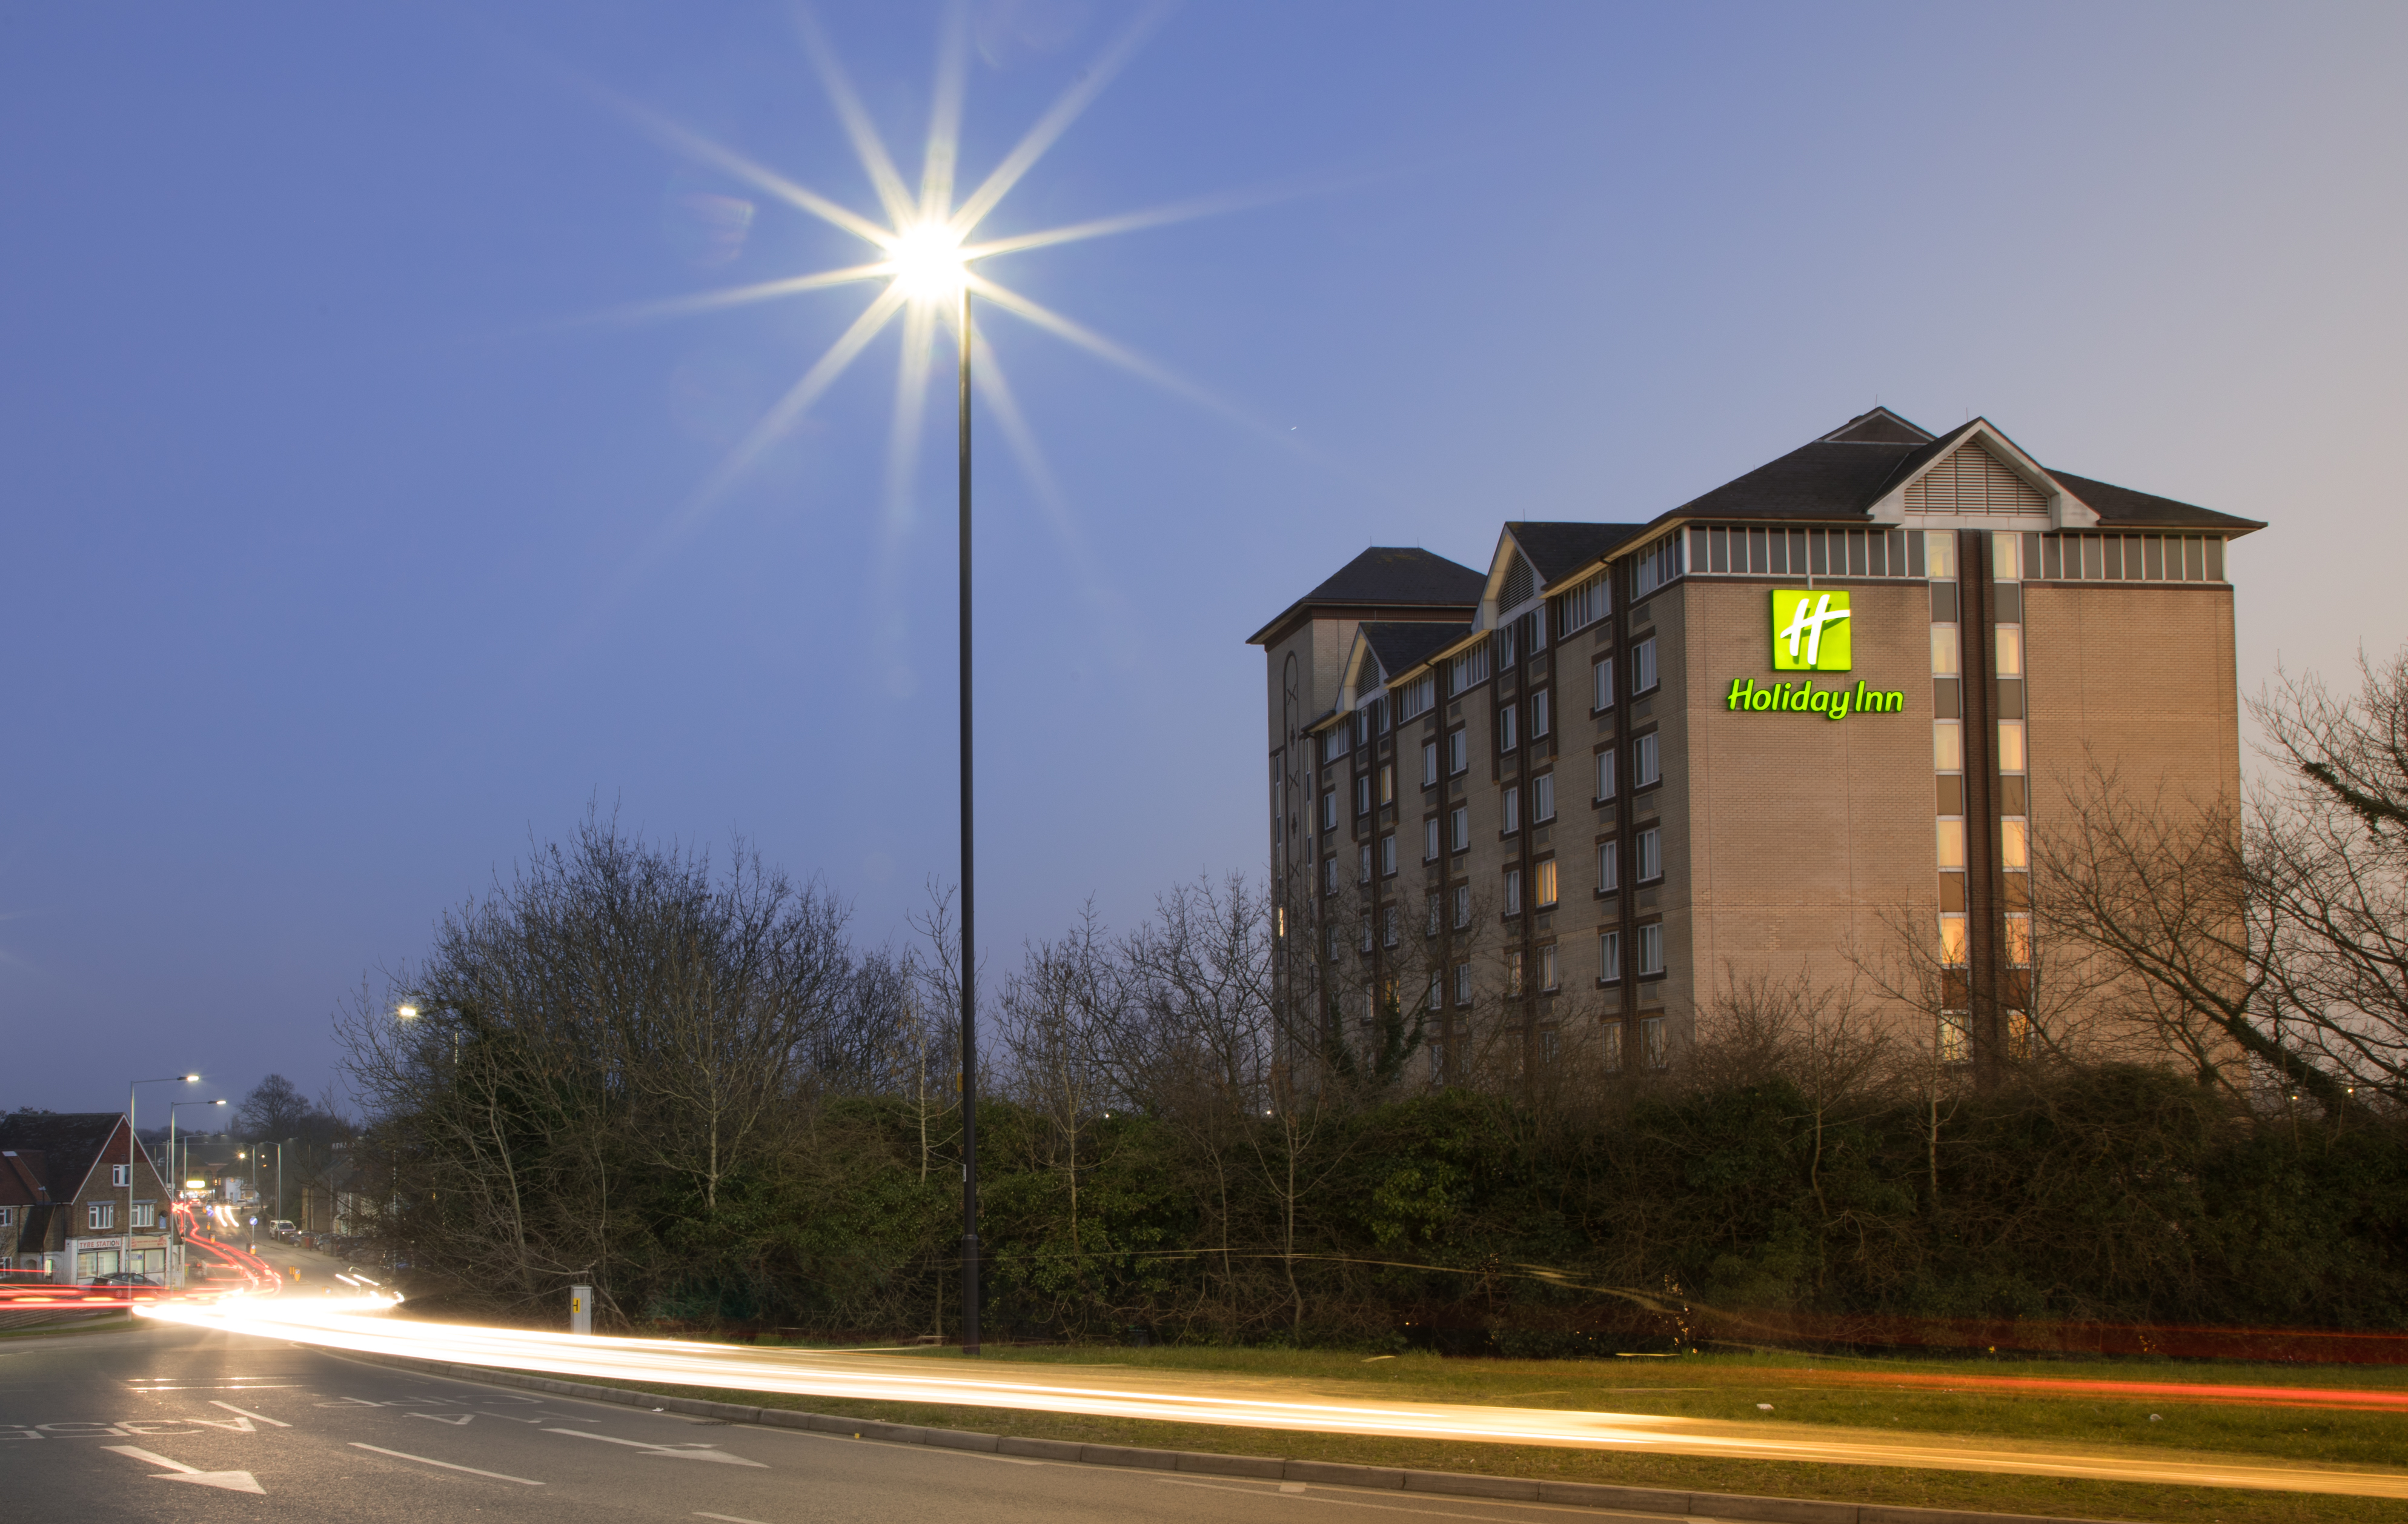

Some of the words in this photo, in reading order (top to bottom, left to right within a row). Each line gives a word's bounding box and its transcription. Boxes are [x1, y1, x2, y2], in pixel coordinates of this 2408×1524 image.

[1780, 594, 1851, 665] H
[1728, 678, 1850, 719] Holiday
[1854, 680, 1903, 711] Inn
[402, 1409, 602, 1425] M4
